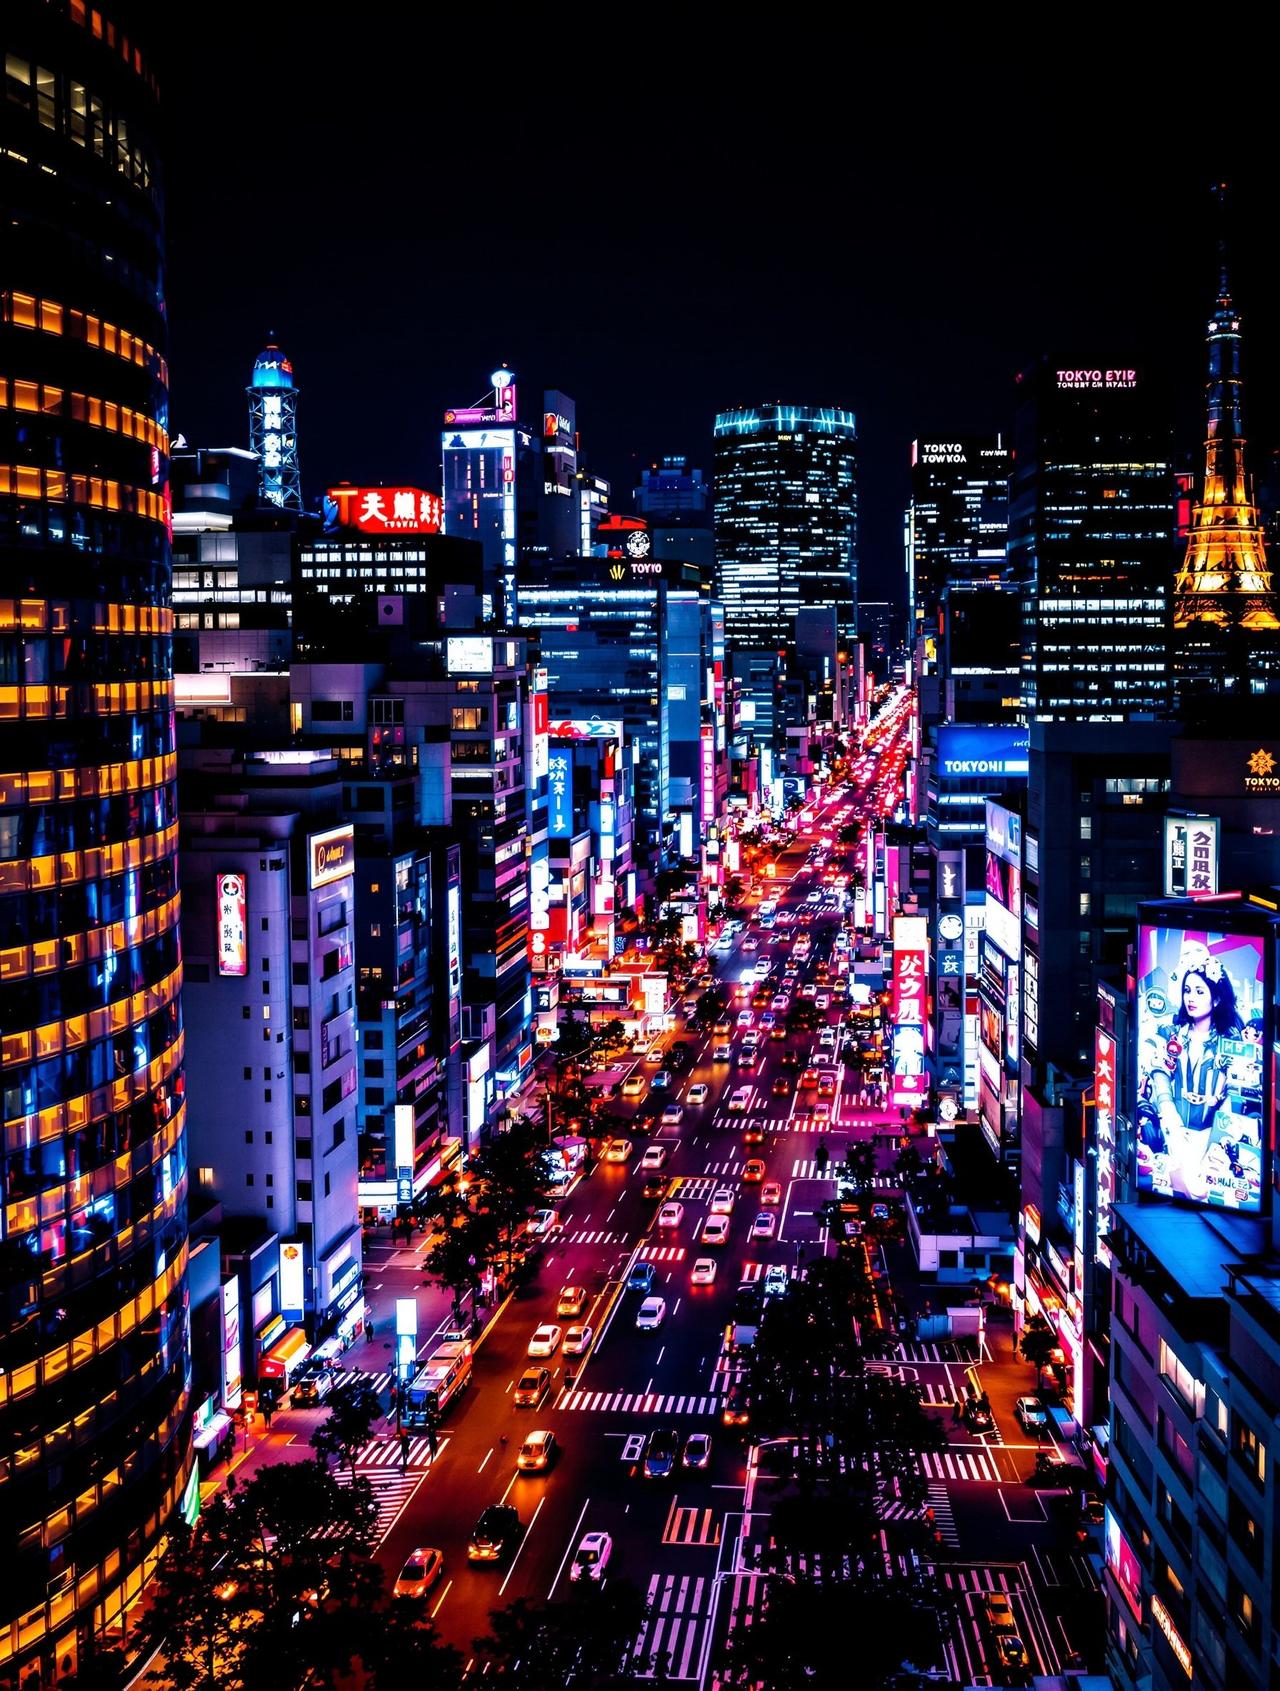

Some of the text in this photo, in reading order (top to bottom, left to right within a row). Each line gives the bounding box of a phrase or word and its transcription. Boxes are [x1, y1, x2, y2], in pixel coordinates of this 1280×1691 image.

[1056, 370, 1102, 382] TOKYO
[924, 443, 962, 453] TOKYO
[1244, 777, 1280, 787] TOKYO
